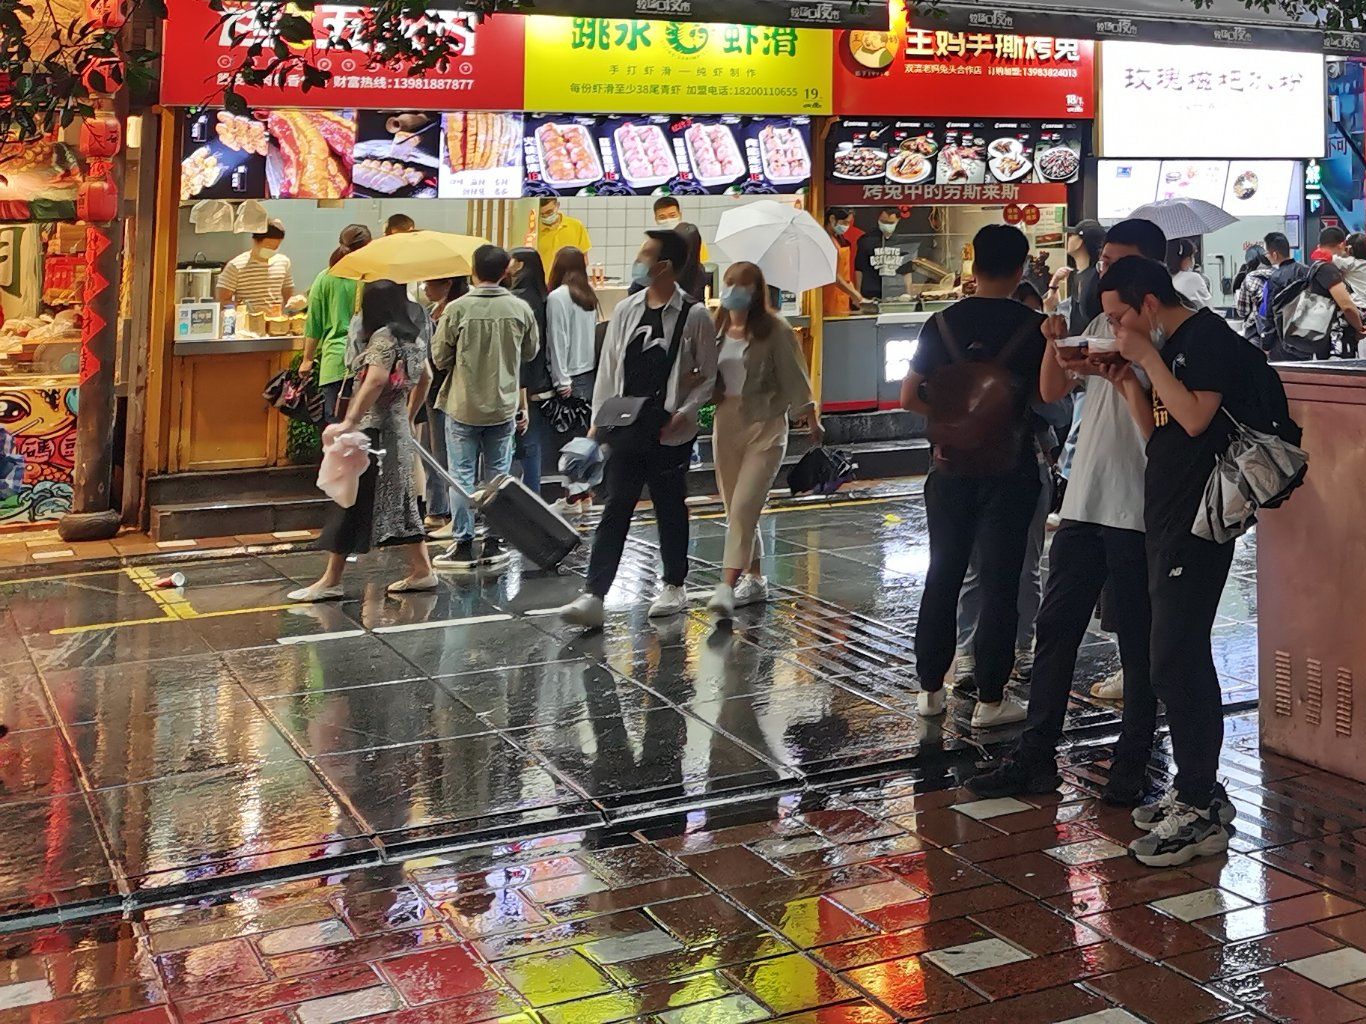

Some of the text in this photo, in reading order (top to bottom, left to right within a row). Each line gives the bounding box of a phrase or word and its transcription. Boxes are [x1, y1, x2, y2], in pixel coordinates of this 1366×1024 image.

[571, 17, 799, 57] 跳水 虾滑
[905, 28, 1080, 62] 王妈手撕烤兔
[570, 83, 682, 96] 每份虾滑至少38尾青虾
[804, 88, 819, 100] 19
